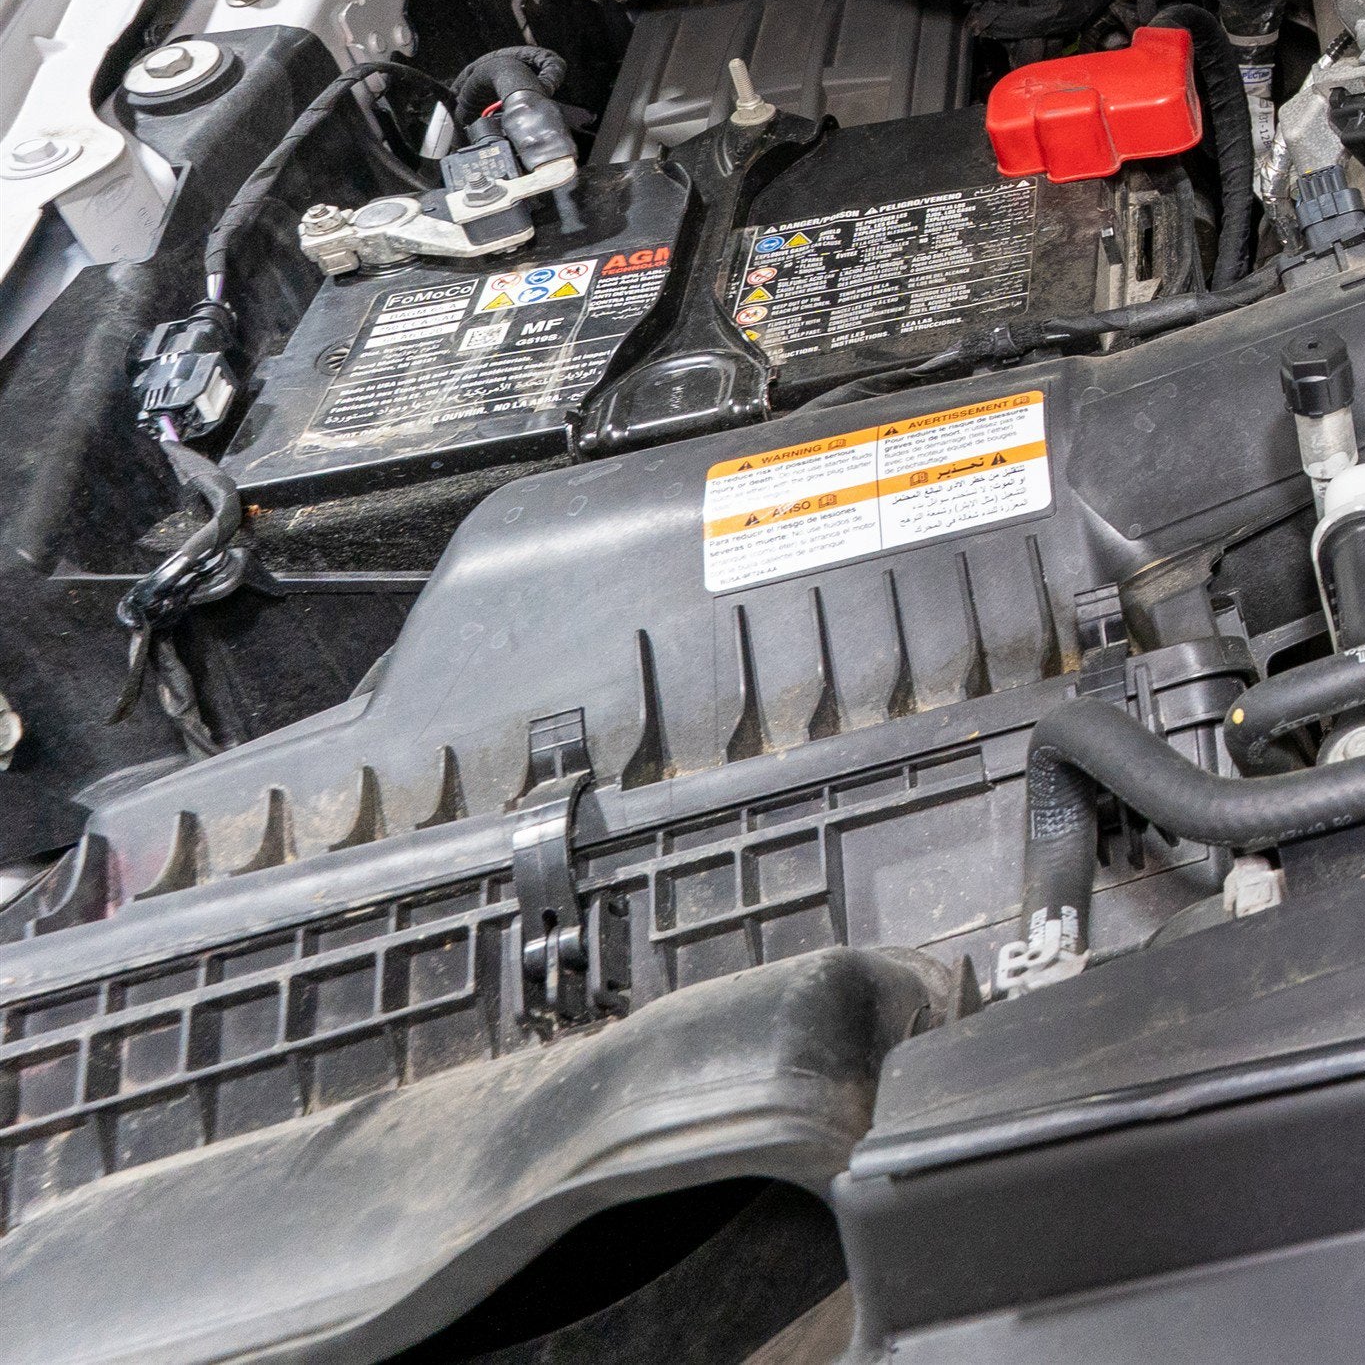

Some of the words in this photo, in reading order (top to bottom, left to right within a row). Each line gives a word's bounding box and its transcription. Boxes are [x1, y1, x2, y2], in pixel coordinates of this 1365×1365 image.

[779, 210, 859, 230] DANGER/POISON
[879, 192, 961, 211] PELIGRO/VENENO
[388, 285, 472, 306] FoMoCo
[521, 317, 563, 335] MF
[850, 330, 865, 338] LES
[338, 387, 364, 396] Made
[376, 381, 396, 389] USA
[492, 402, 510, 411] NO
[511, 399, 527, 408] LA
[908, 400, 1007, 428] AVERTISSEMENT
[884, 436, 904, 444] Pour
[948, 420, 974, 429] risque
[988, 407, 1028, 420] blessures
[761, 444, 821, 463] WARNING
[884, 441, 912, 452] graves
[723, 473, 753, 482] reduce
[785, 456, 821, 469] possible
[824, 449, 855, 459] serious
[820, 507, 855, 519] lesiones
[852, 521, 875, 530] motor
